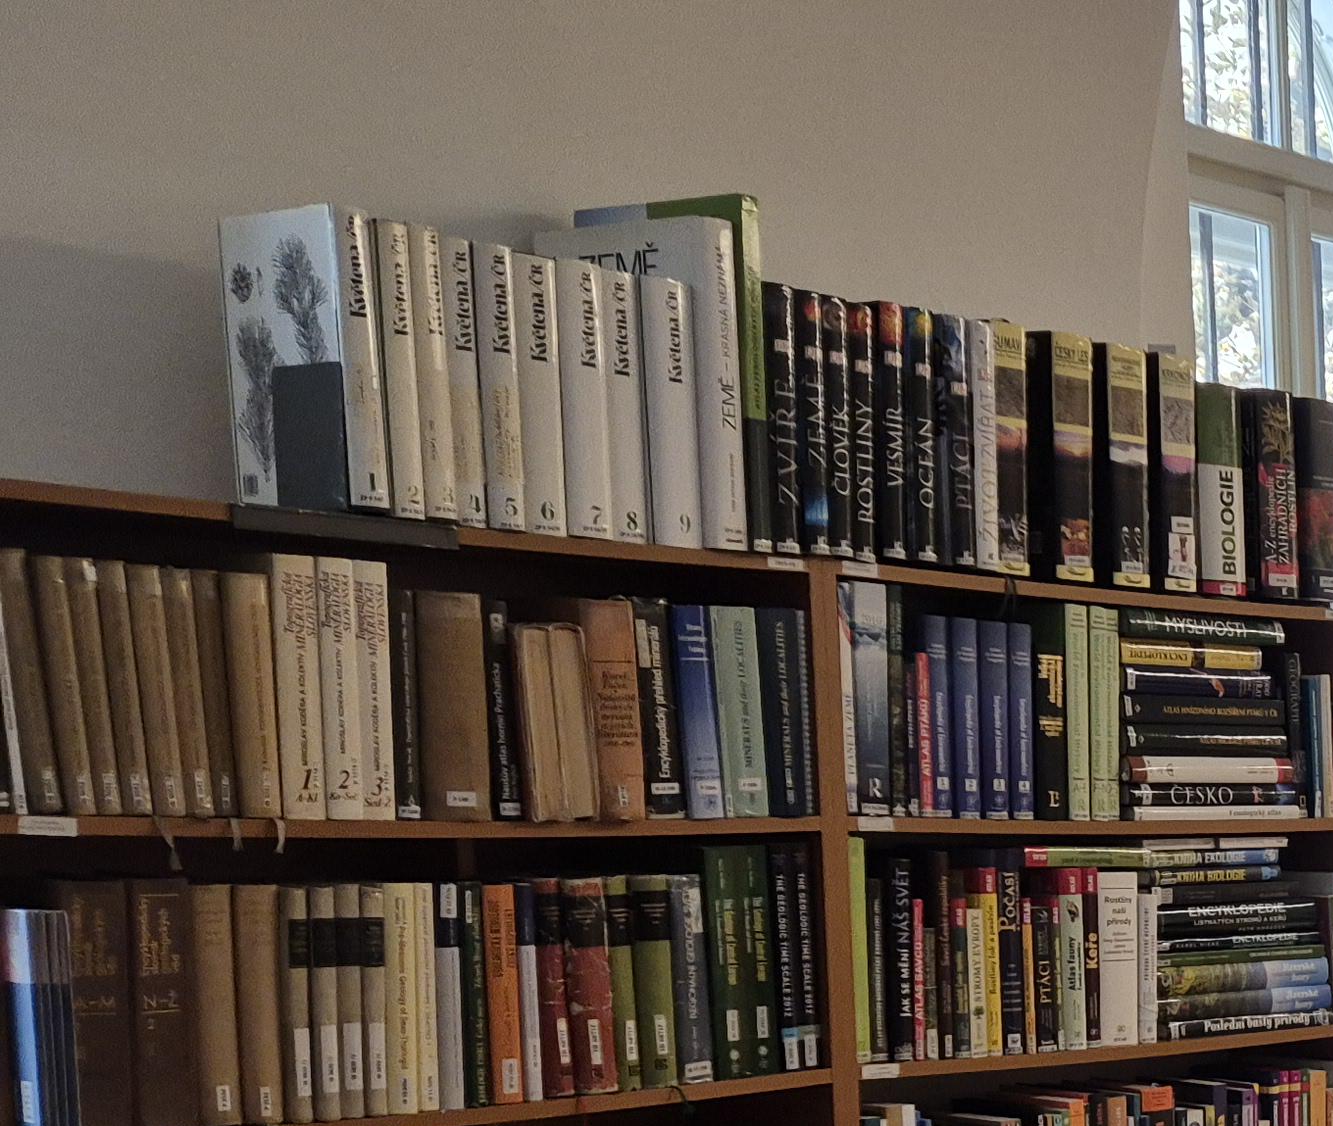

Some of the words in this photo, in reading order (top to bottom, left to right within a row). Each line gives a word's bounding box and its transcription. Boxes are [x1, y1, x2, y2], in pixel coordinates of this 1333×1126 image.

[453, 252, 472, 352] Květena/ČR
[491, 255, 510, 354] Květena/ČR
[529, 265, 548, 362] Květena/ČR
[580, 273, 597, 368] Květena/ČR
[613, 282, 630, 376] Květena/ČR
[666, 290, 683, 383] Květena/ČR
[717, 376, 737, 431] ZEMĚ
[769, 379, 799, 504] ZVÍŘE
[830, 405, 850, 495] ČLOVĚK
[882, 407, 904, 487] VESMÍR
[855, 399, 875, 523] ROSTLINY
[914, 417, 934, 509] OCEÁN
[950, 433, 972, 509] PTÁCI
[505, 497, 518, 516] 5
[541, 501, 555, 522] 6
[1287, 470, 1297, 532] ROSTLIN
[626, 511, 638, 530] 8
[680, 513, 690, 533] 9
[1219, 471, 1236, 576] BIOLOGIE
[1273, 468, 1290, 564] ZAHRADNÍCH
[1264, 540, 1277, 563] A-Z
[306, 576, 316, 638] SLOVENSKA
[342, 575, 352, 633] SLOVENSKA
[376, 583, 386, 644] SLOVENSKA
[1164, 615, 1247, 638] MYSLIVOSTI
[921, 740, 931, 777] ATLAS
[301, 768, 312, 791] 1
[338, 770, 350, 790] 2
[371, 776, 384, 797] 3
[1170, 783, 1234, 805] ČESKO
[1204, 851, 1246, 863] EKOLOGIE
[776, 874, 785, 891] THE
[797, 872, 806, 889] THE
[891, 868, 909, 906] SVĚT
[1207, 869, 1247, 881] BIOLOGIE
[798, 892, 809, 936] GEOLOGIC
[1023, 903, 1031, 925] ATLAS
[1104, 896, 1132, 905] Rostliny
[1188, 901, 1287, 918] ENCYKLOPEDIE
[777, 894, 787, 938] GEOLOGIC
[891, 912, 910, 943] NÁŠ
[801, 939, 811, 960] TIME
[971, 915, 981, 955] EVROPY
[780, 942, 790, 962] TIME
[896, 949, 909, 978] MĚNÍ
[1067, 937, 1077, 965] fauny
[1086, 933, 1098, 970] Keře
[781, 965, 792, 993] SCALE
[802, 962, 812, 990] SCALE
[899, 983, 910, 995] SE
[1037, 961, 1052, 1004] PTÁCI
[1068, 967, 1077, 991] Atlas
[783, 996, 793, 1018] 2012
[804, 994, 815, 1015] 2012
[899, 998, 912, 1017] JAK
[915, 984, 924, 1020] ATLAS
[1203, 1018, 1245, 1034] Poslední
[1274, 1012, 1311, 1029] přírody
